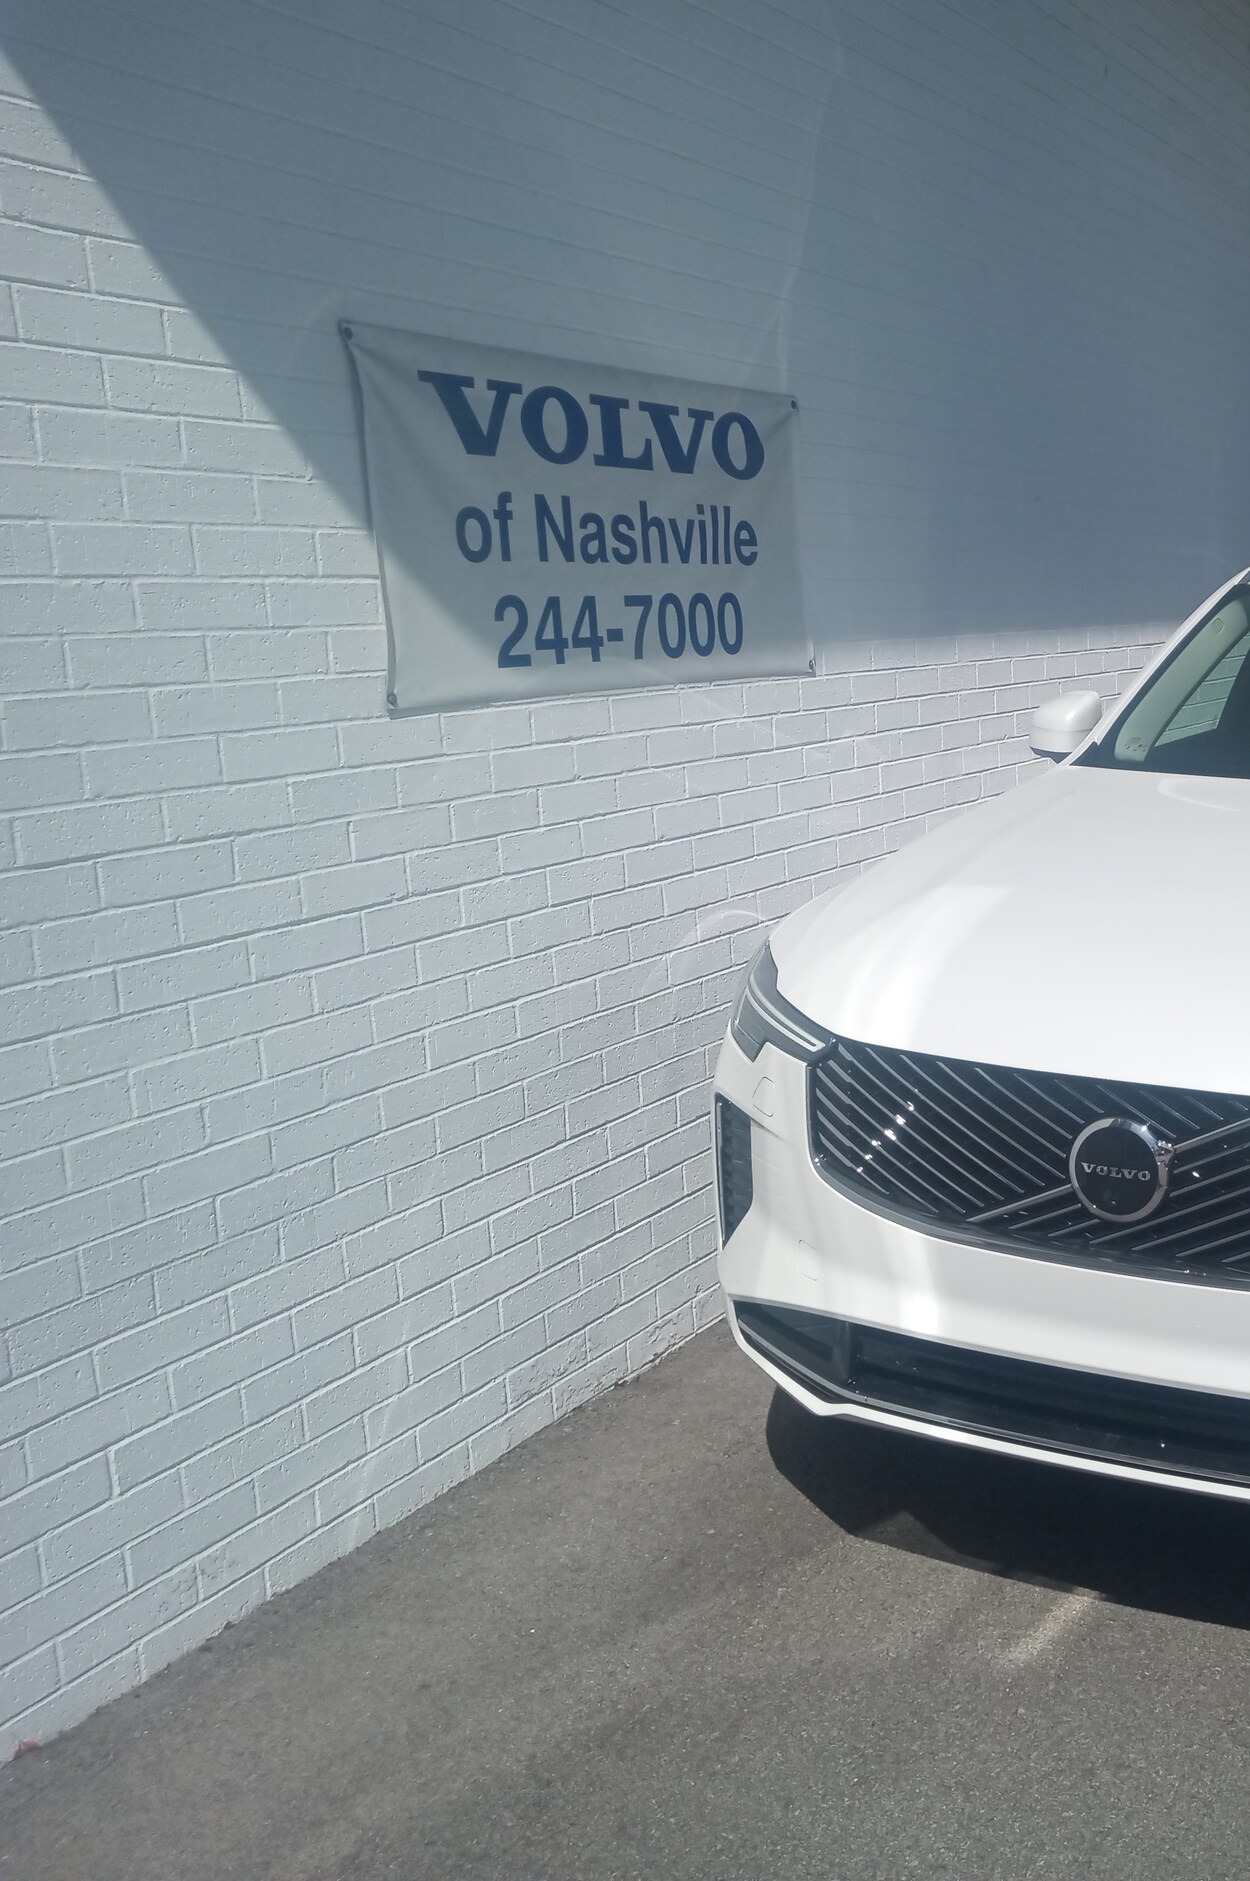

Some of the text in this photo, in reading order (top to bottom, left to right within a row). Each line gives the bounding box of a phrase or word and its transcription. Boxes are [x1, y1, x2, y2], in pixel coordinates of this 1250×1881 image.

[417, 369, 765, 481] VOLVO
[455, 491, 759, 567] of Nashville
[494, 591, 744, 669] 244-7000
[1080, 1161, 1151, 1181] VOLVO
